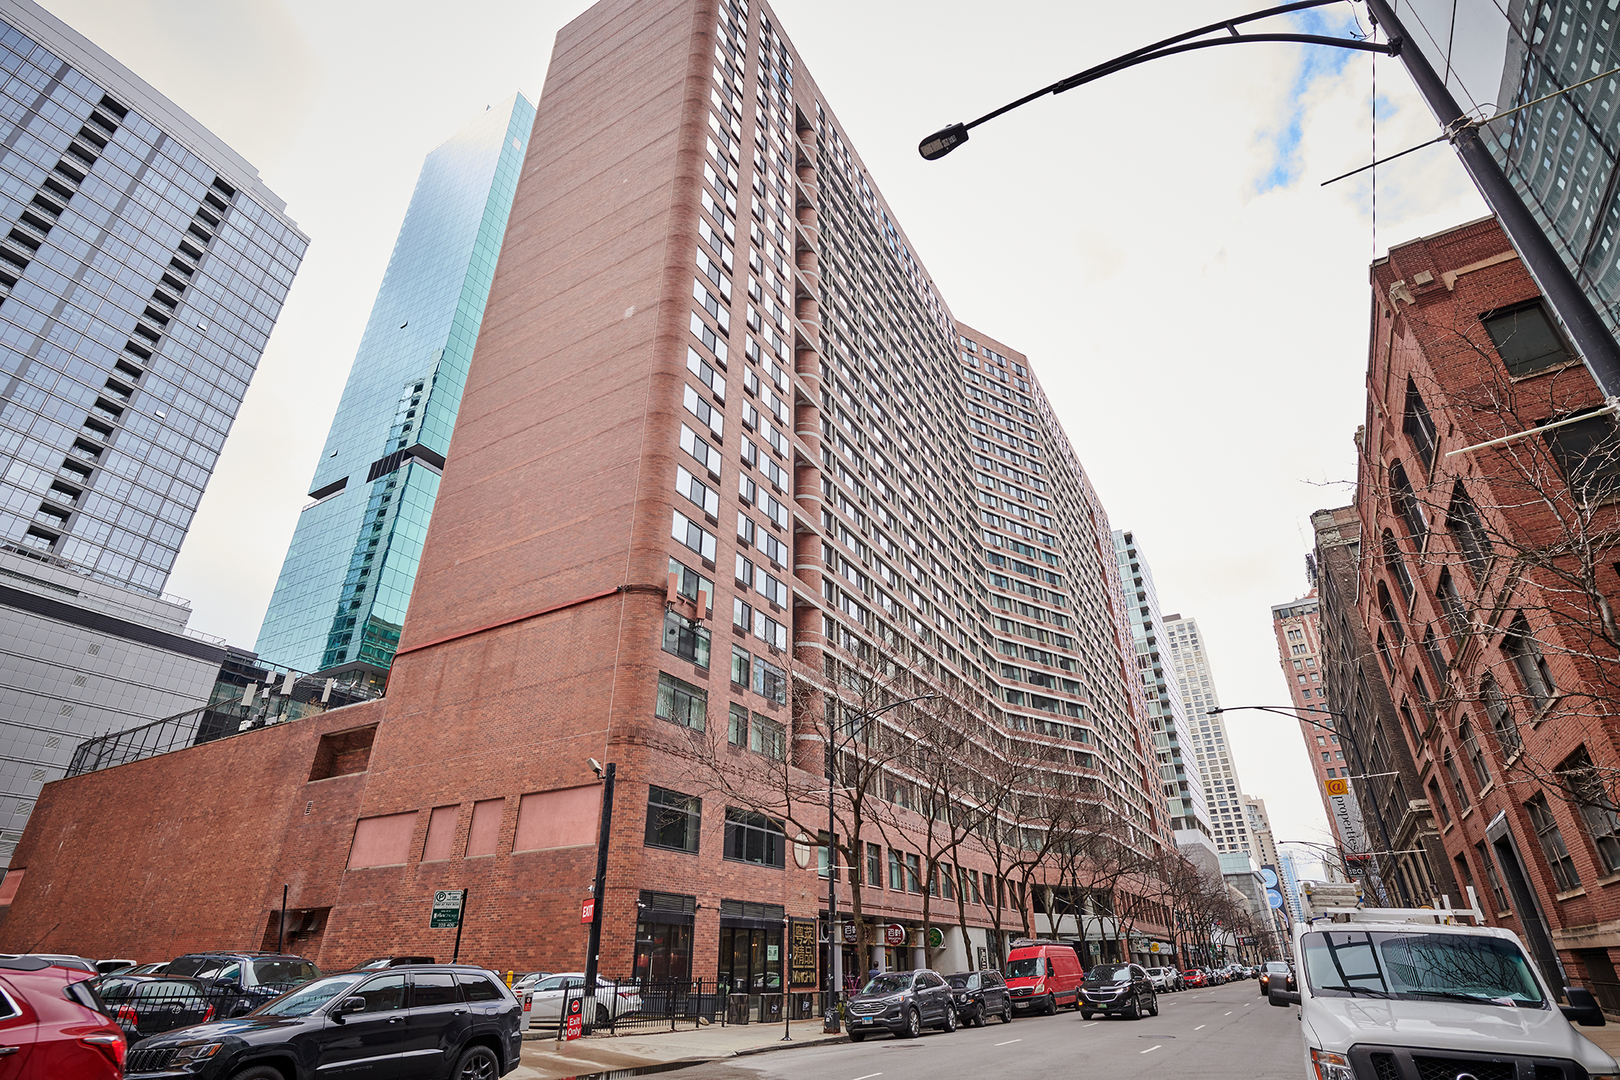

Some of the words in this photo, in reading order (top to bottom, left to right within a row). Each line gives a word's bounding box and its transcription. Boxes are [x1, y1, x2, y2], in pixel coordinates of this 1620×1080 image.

[1332, 796, 1359, 851] properties
[583, 904, 594, 918] EXIT
[569, 1016, 581, 1027] Exit
[567, 1027, 581, 1037] Only
